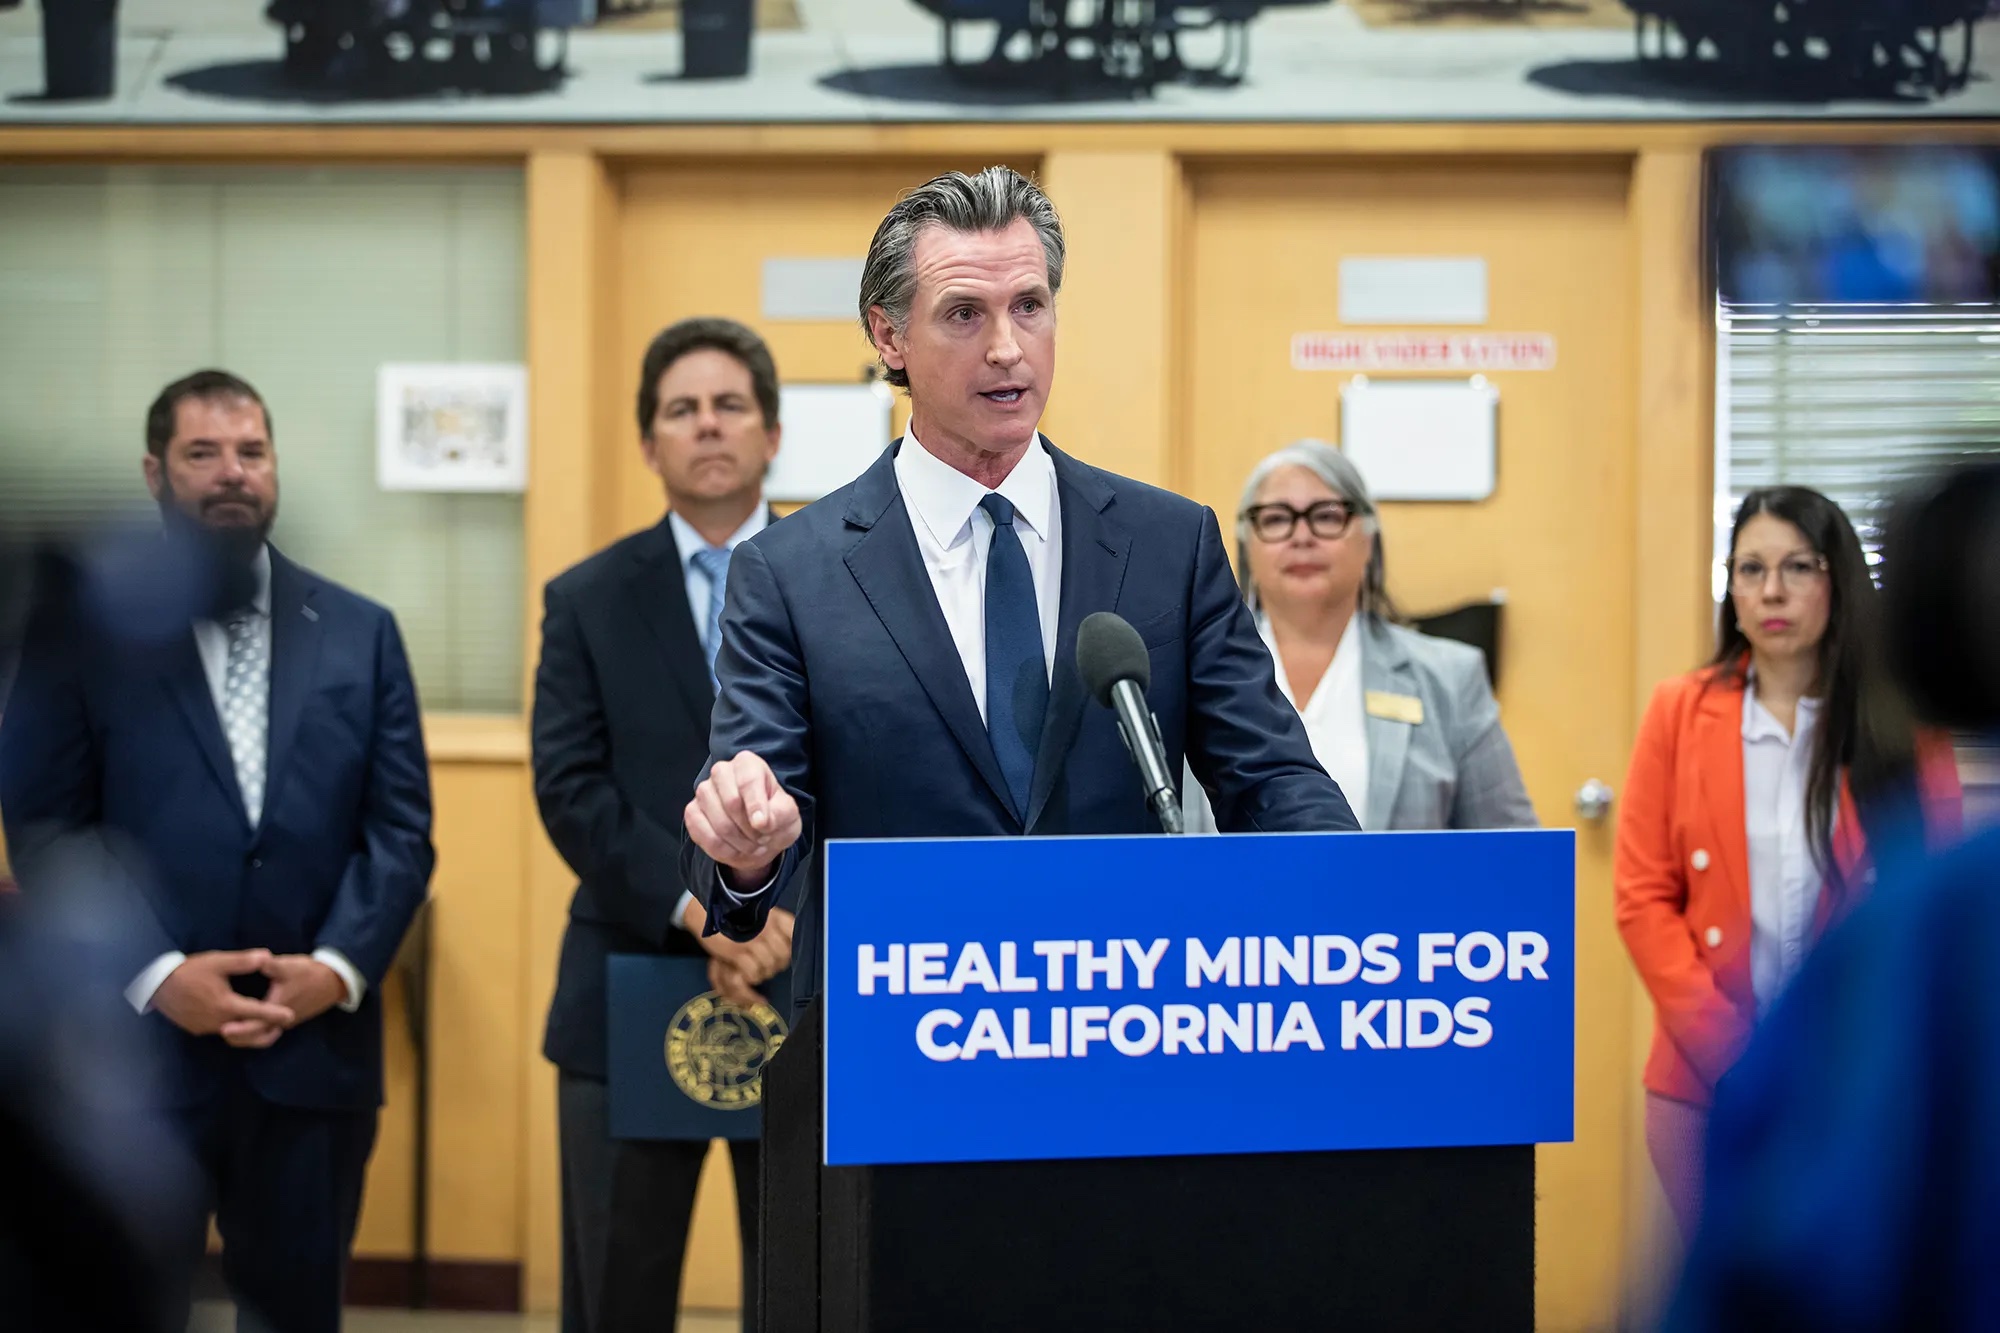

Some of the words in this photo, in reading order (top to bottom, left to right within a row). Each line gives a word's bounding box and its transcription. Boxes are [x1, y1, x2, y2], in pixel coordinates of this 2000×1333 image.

[857, 938, 1170, 996] HEALTHY
[1185, 933, 1402, 988] MINDS
[1418, 931, 1550, 983] FOR
[915, 1001, 1325, 1062] CALIFORNIA
[1340, 996, 1493, 1050] KIDS
